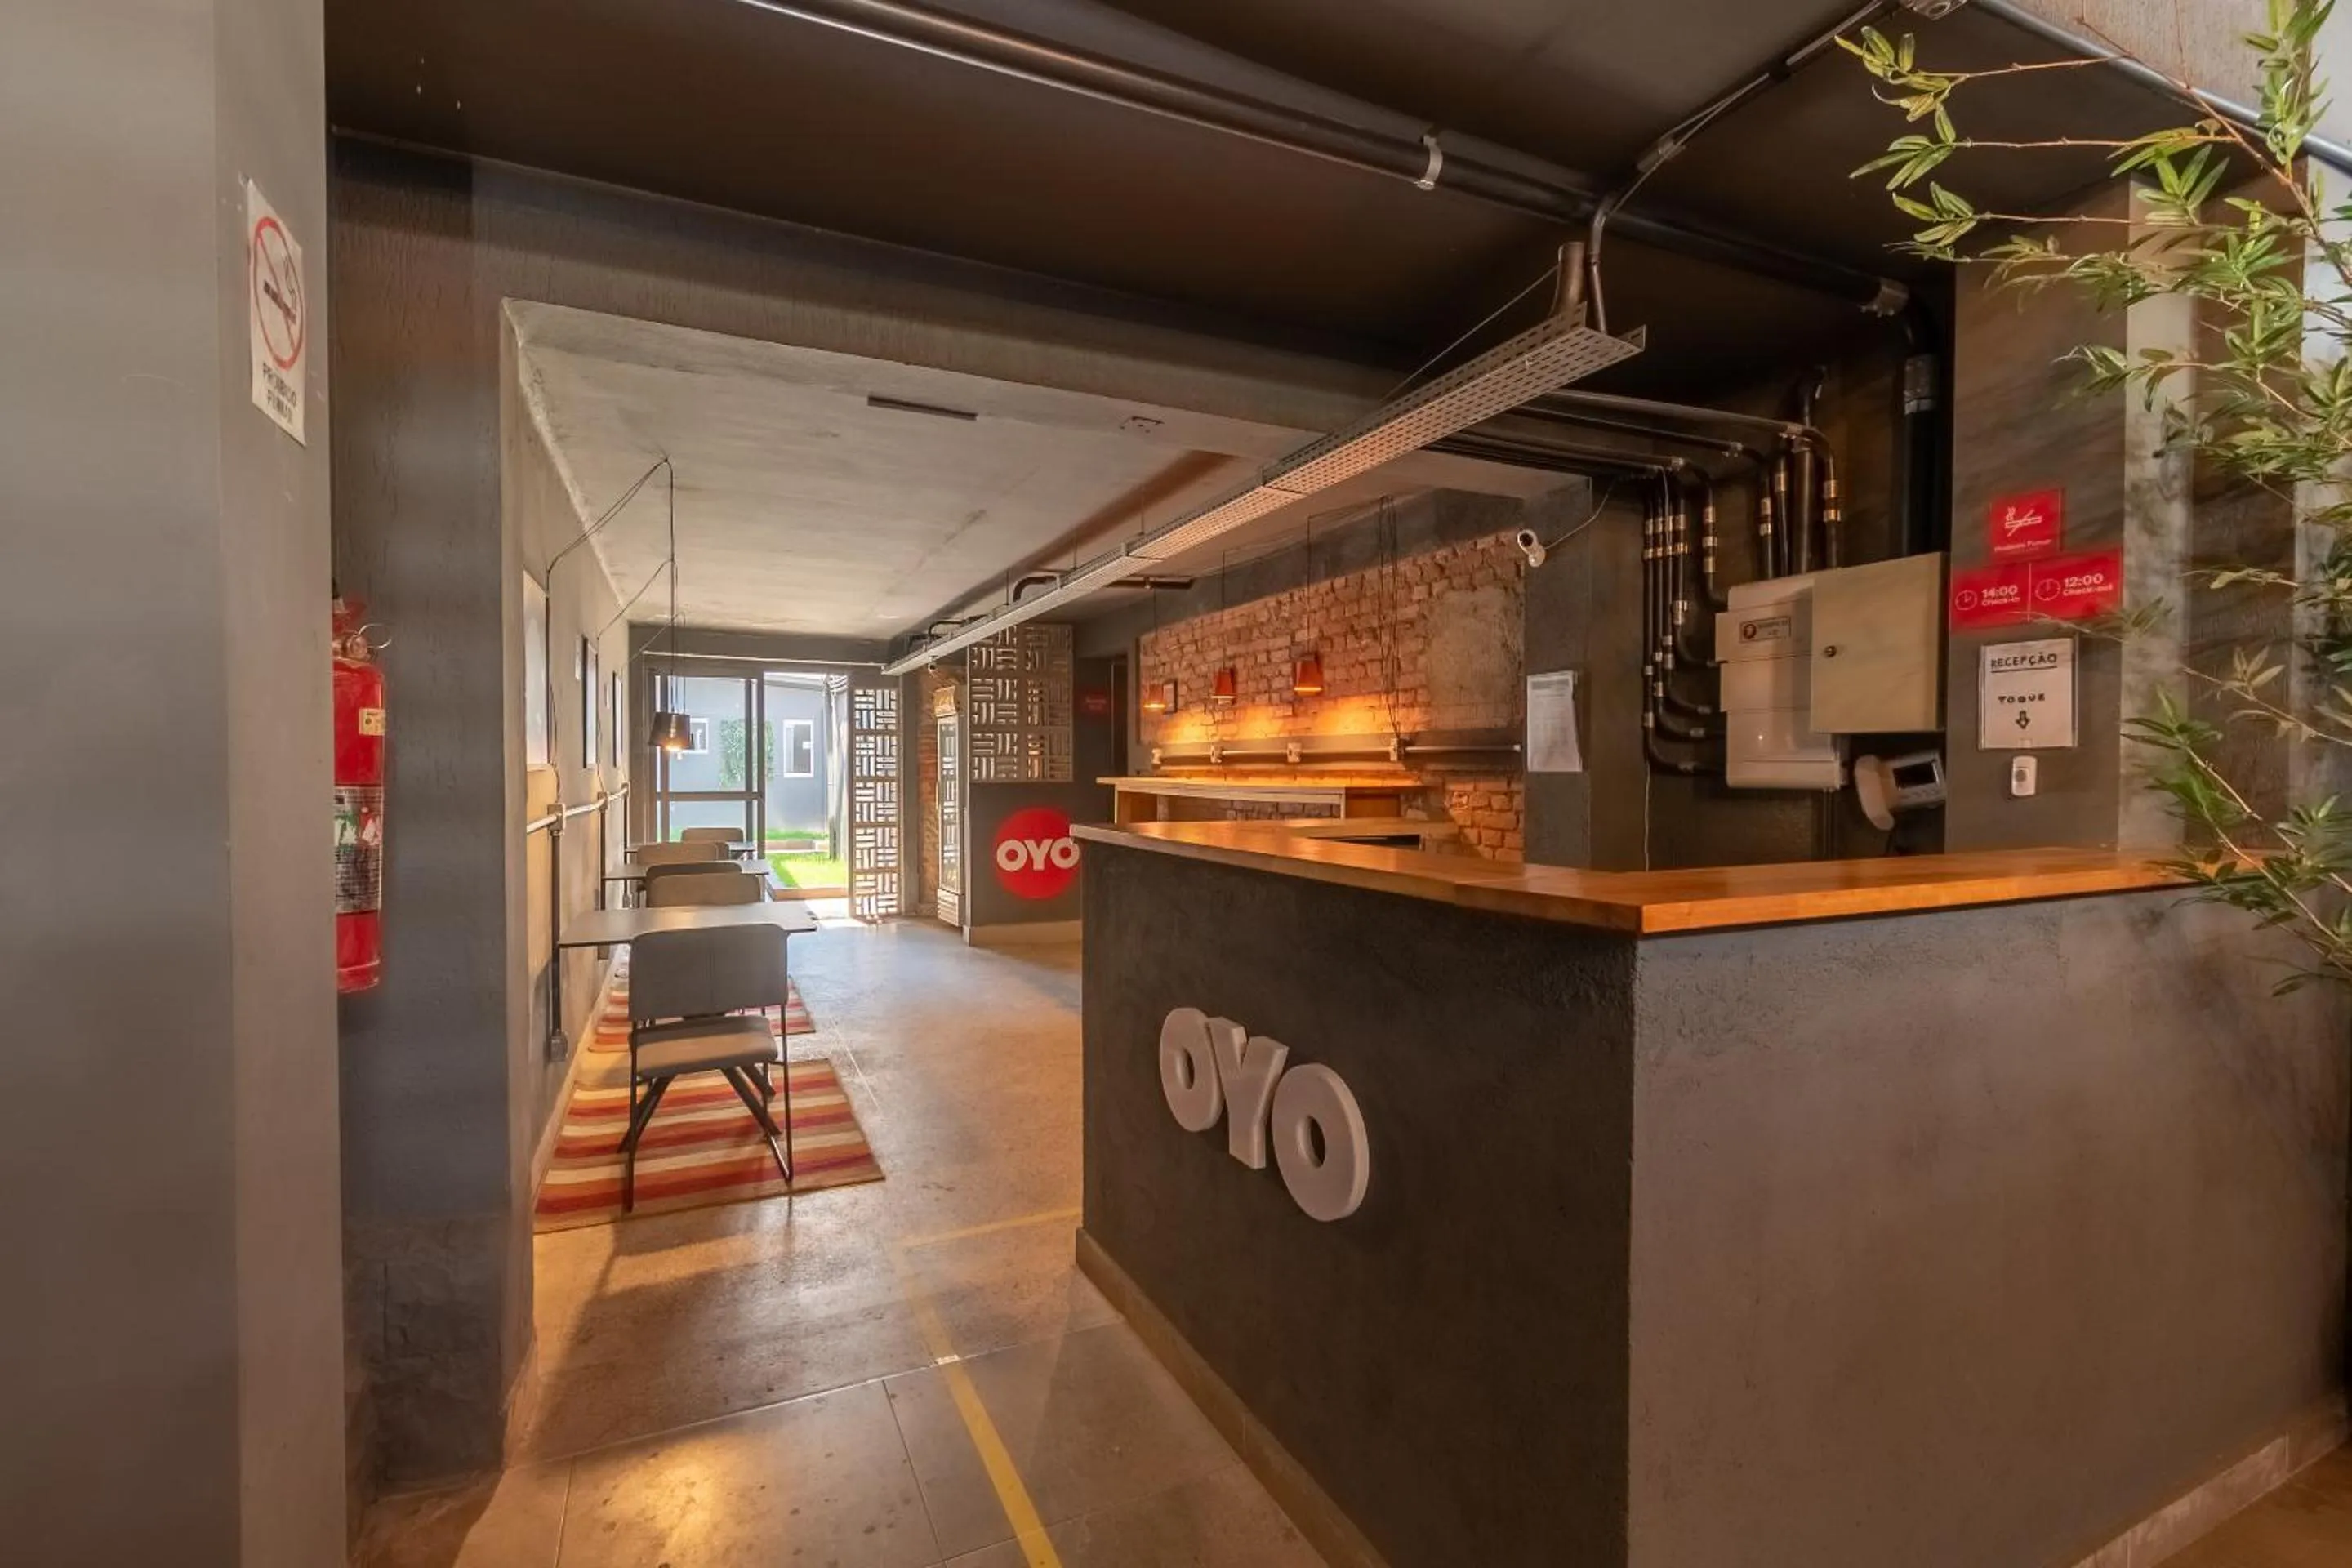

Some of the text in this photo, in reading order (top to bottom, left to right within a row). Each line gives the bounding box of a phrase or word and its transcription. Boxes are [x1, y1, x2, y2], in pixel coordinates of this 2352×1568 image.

[2064, 573, 2104, 587] 12:00
[1981, 585, 2018, 598] 14:00
[1991, 652, 2057, 667] RECEPÇÃO
[1998, 693, 2045, 703] TOQUE
[996, 837, 1080, 871] OYO
[1160, 1007, 1370, 1222] OYO
